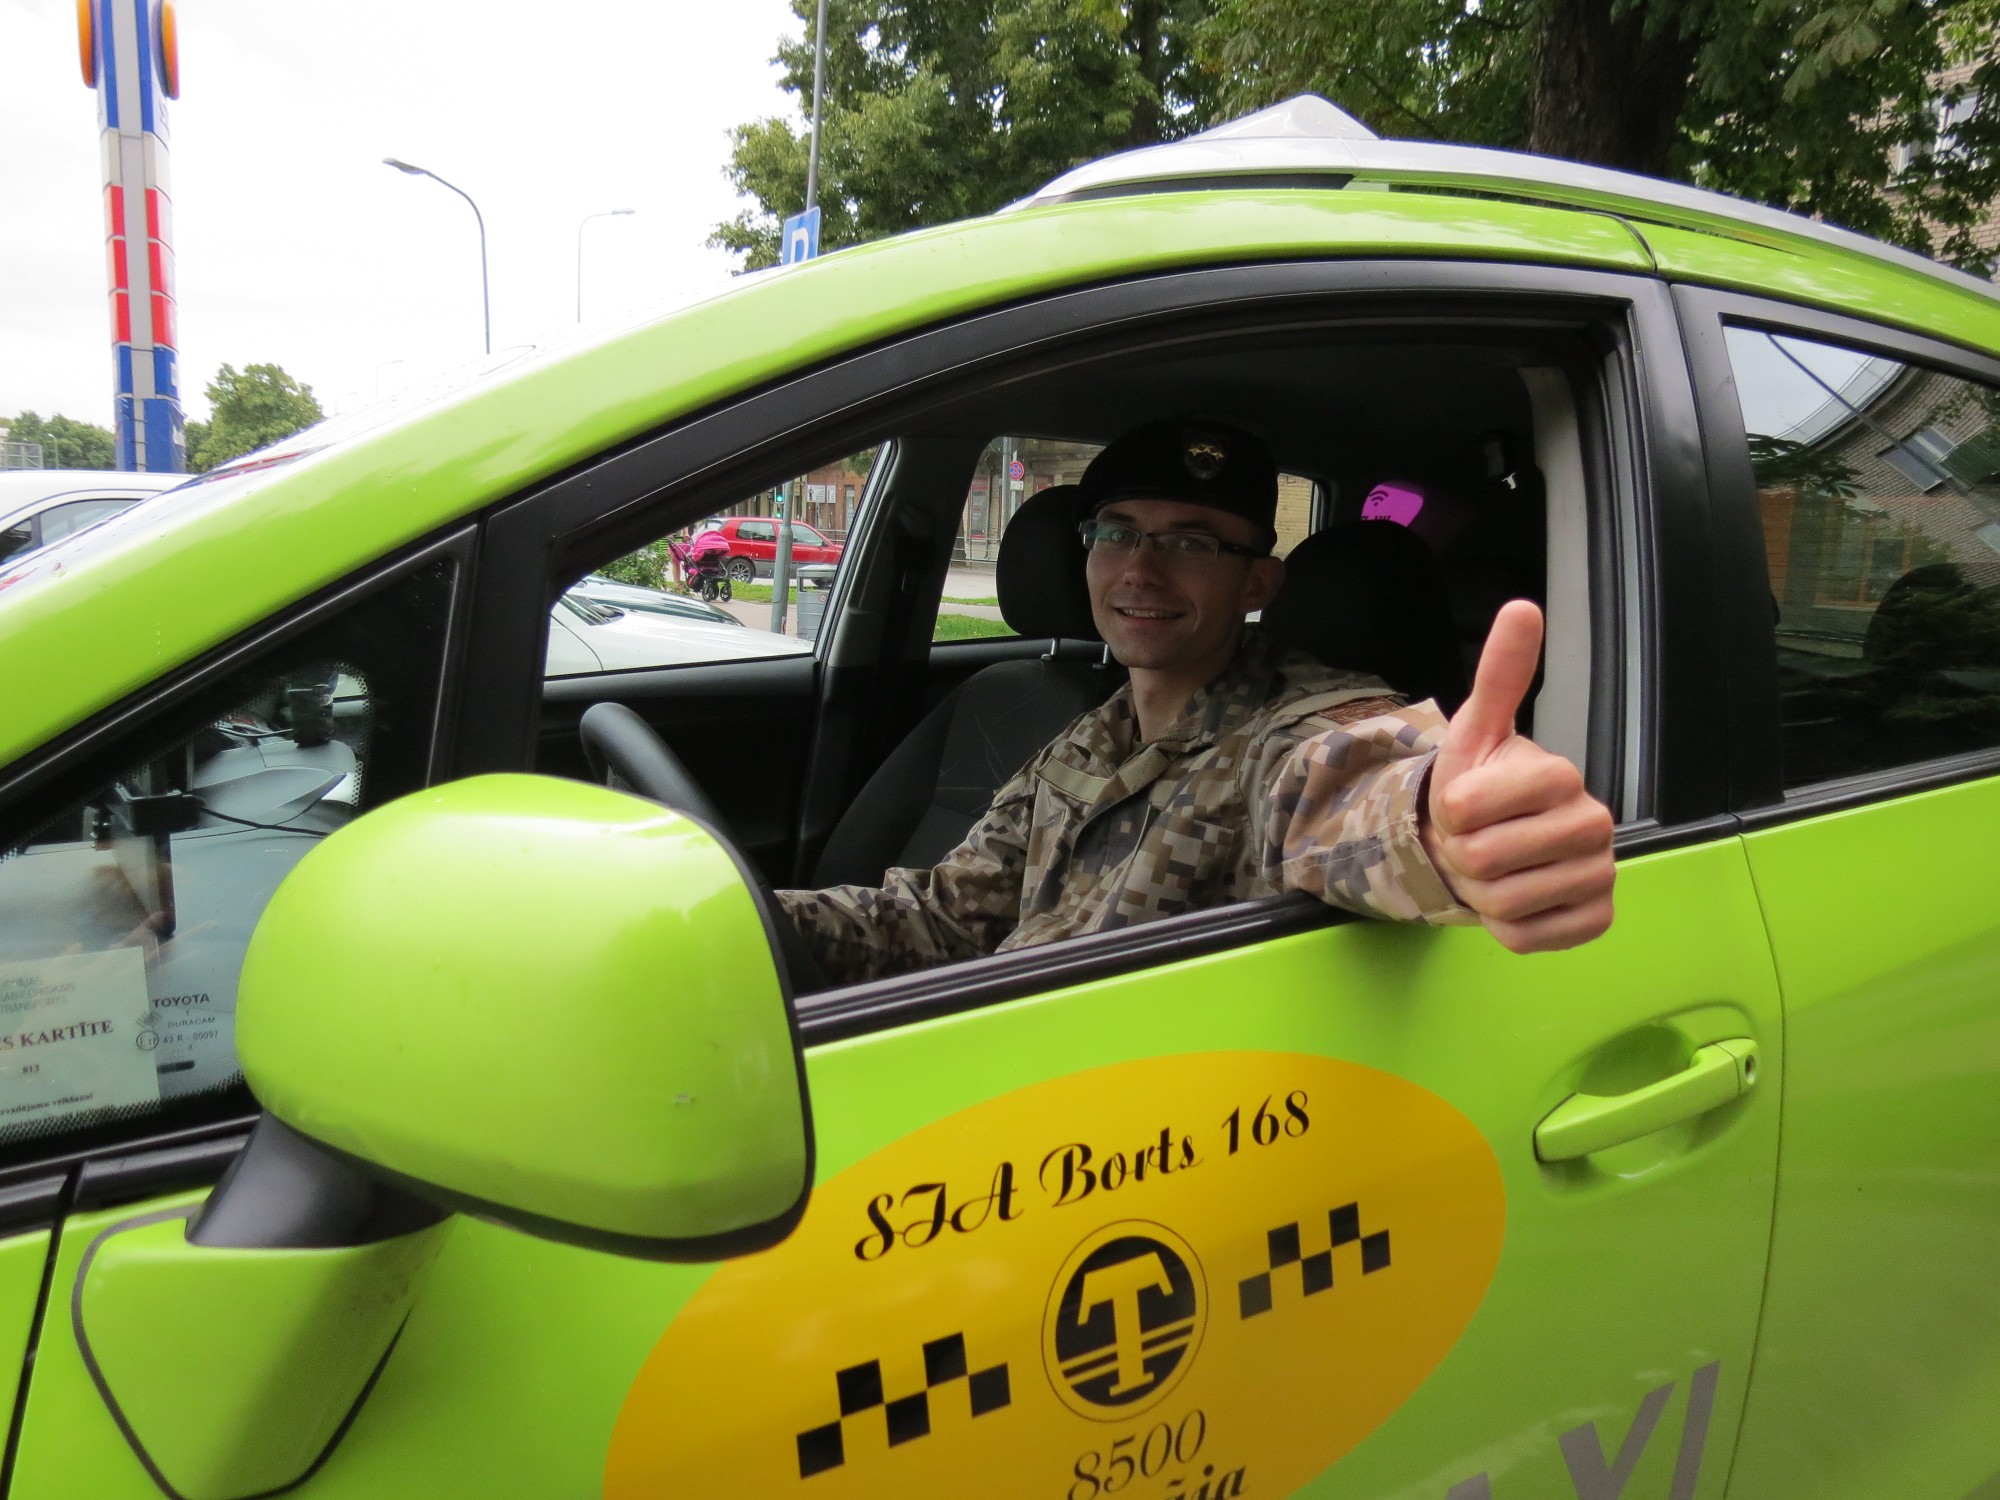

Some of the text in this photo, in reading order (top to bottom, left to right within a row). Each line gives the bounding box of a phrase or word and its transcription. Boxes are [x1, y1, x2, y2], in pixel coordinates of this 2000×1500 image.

[152, 992, 211, 1009] TOYOTA
[20, 1019, 114, 1048] KARTĪTE
[1039, 1126, 1204, 1207] Borts
[1221, 1089, 1311, 1157] 168
[1066, 1408, 1206, 1500] 8500
